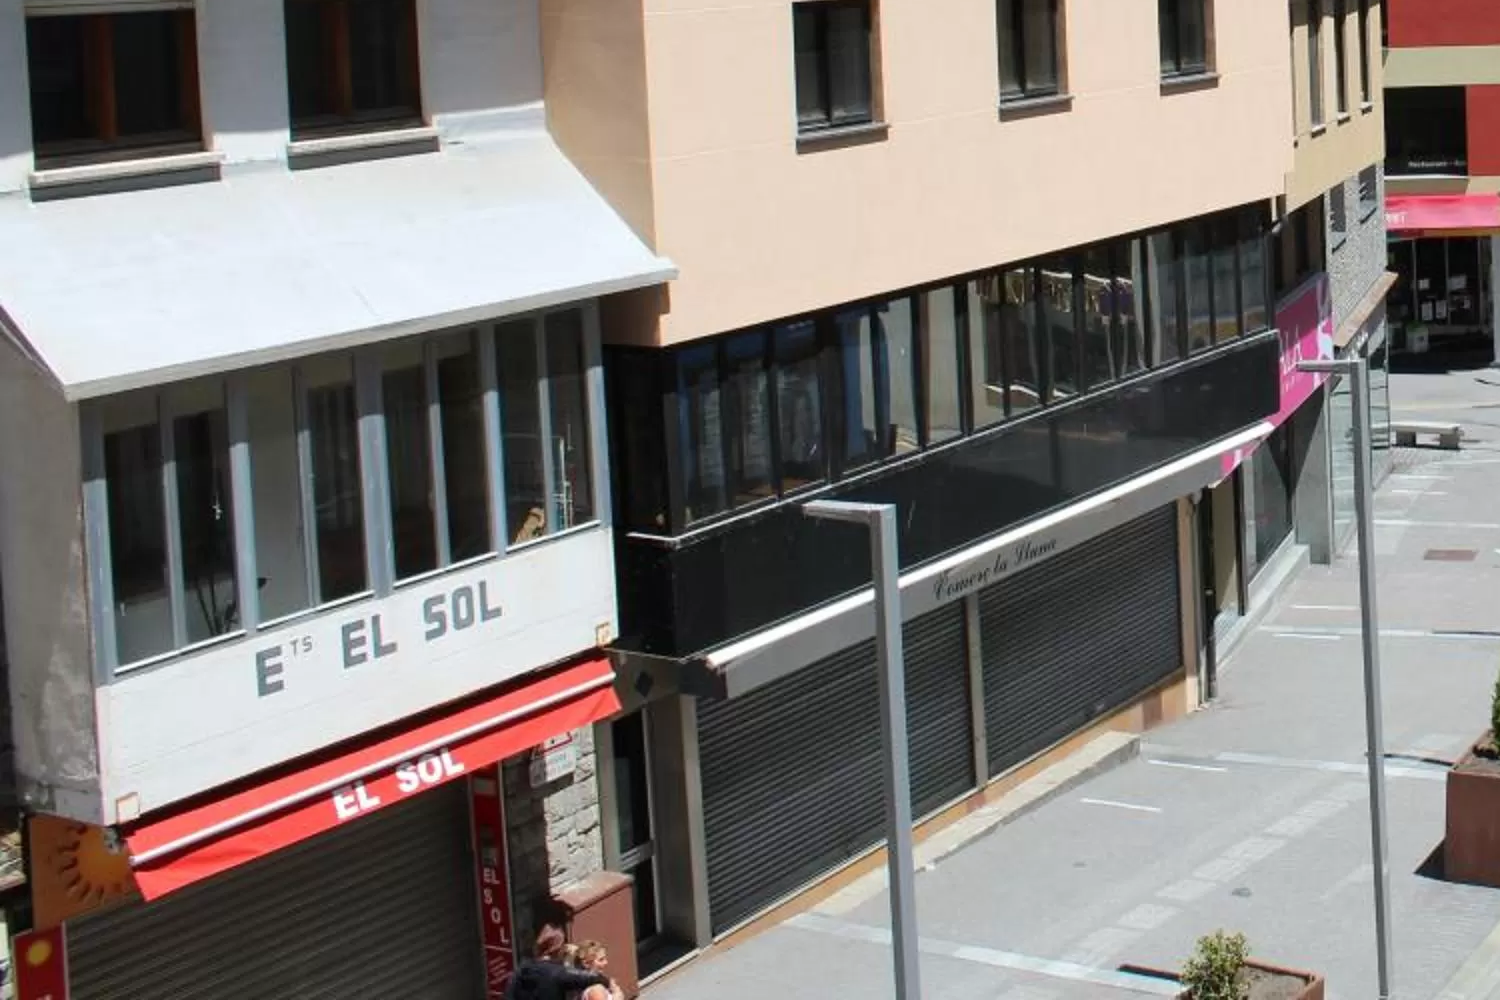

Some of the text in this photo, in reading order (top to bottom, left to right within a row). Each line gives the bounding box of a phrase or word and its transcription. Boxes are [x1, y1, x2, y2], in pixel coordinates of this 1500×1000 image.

[341, 614, 397, 668] EL
[423, 580, 502, 641] SOL
[332, 745, 465, 822] EL SOL
